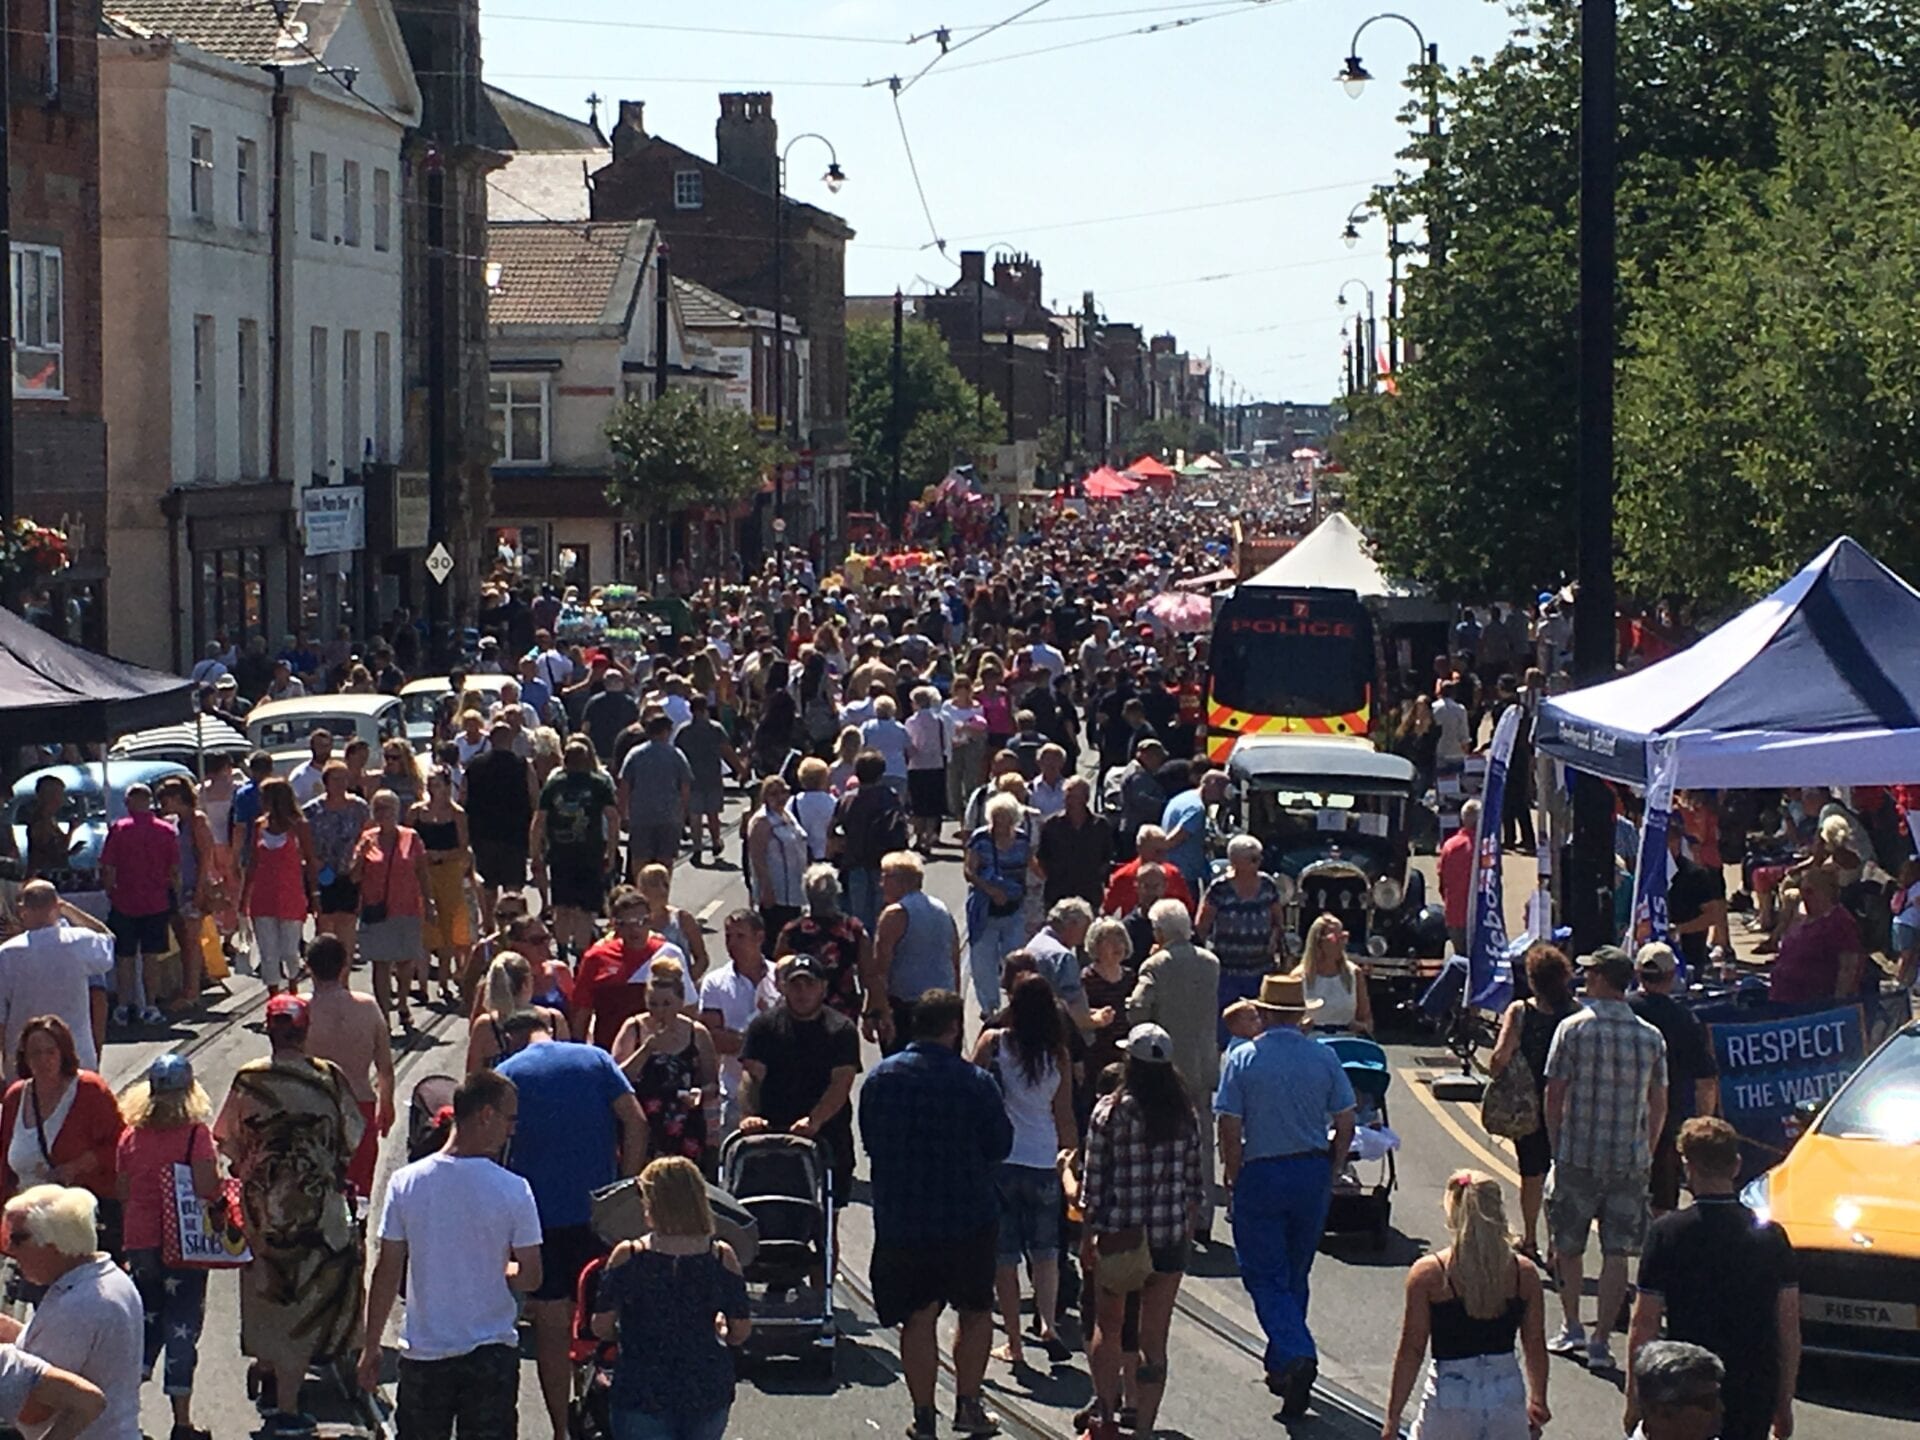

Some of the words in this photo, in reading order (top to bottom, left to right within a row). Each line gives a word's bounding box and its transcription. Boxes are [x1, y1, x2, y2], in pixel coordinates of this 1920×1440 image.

[431, 557, 450, 570] 30
[1231, 618, 1353, 636] POLICE
[1727, 1021, 1846, 1068] RESPECT
[1734, 1082, 1775, 1109] THE
[1824, 1302, 1892, 1322] FIESTA
